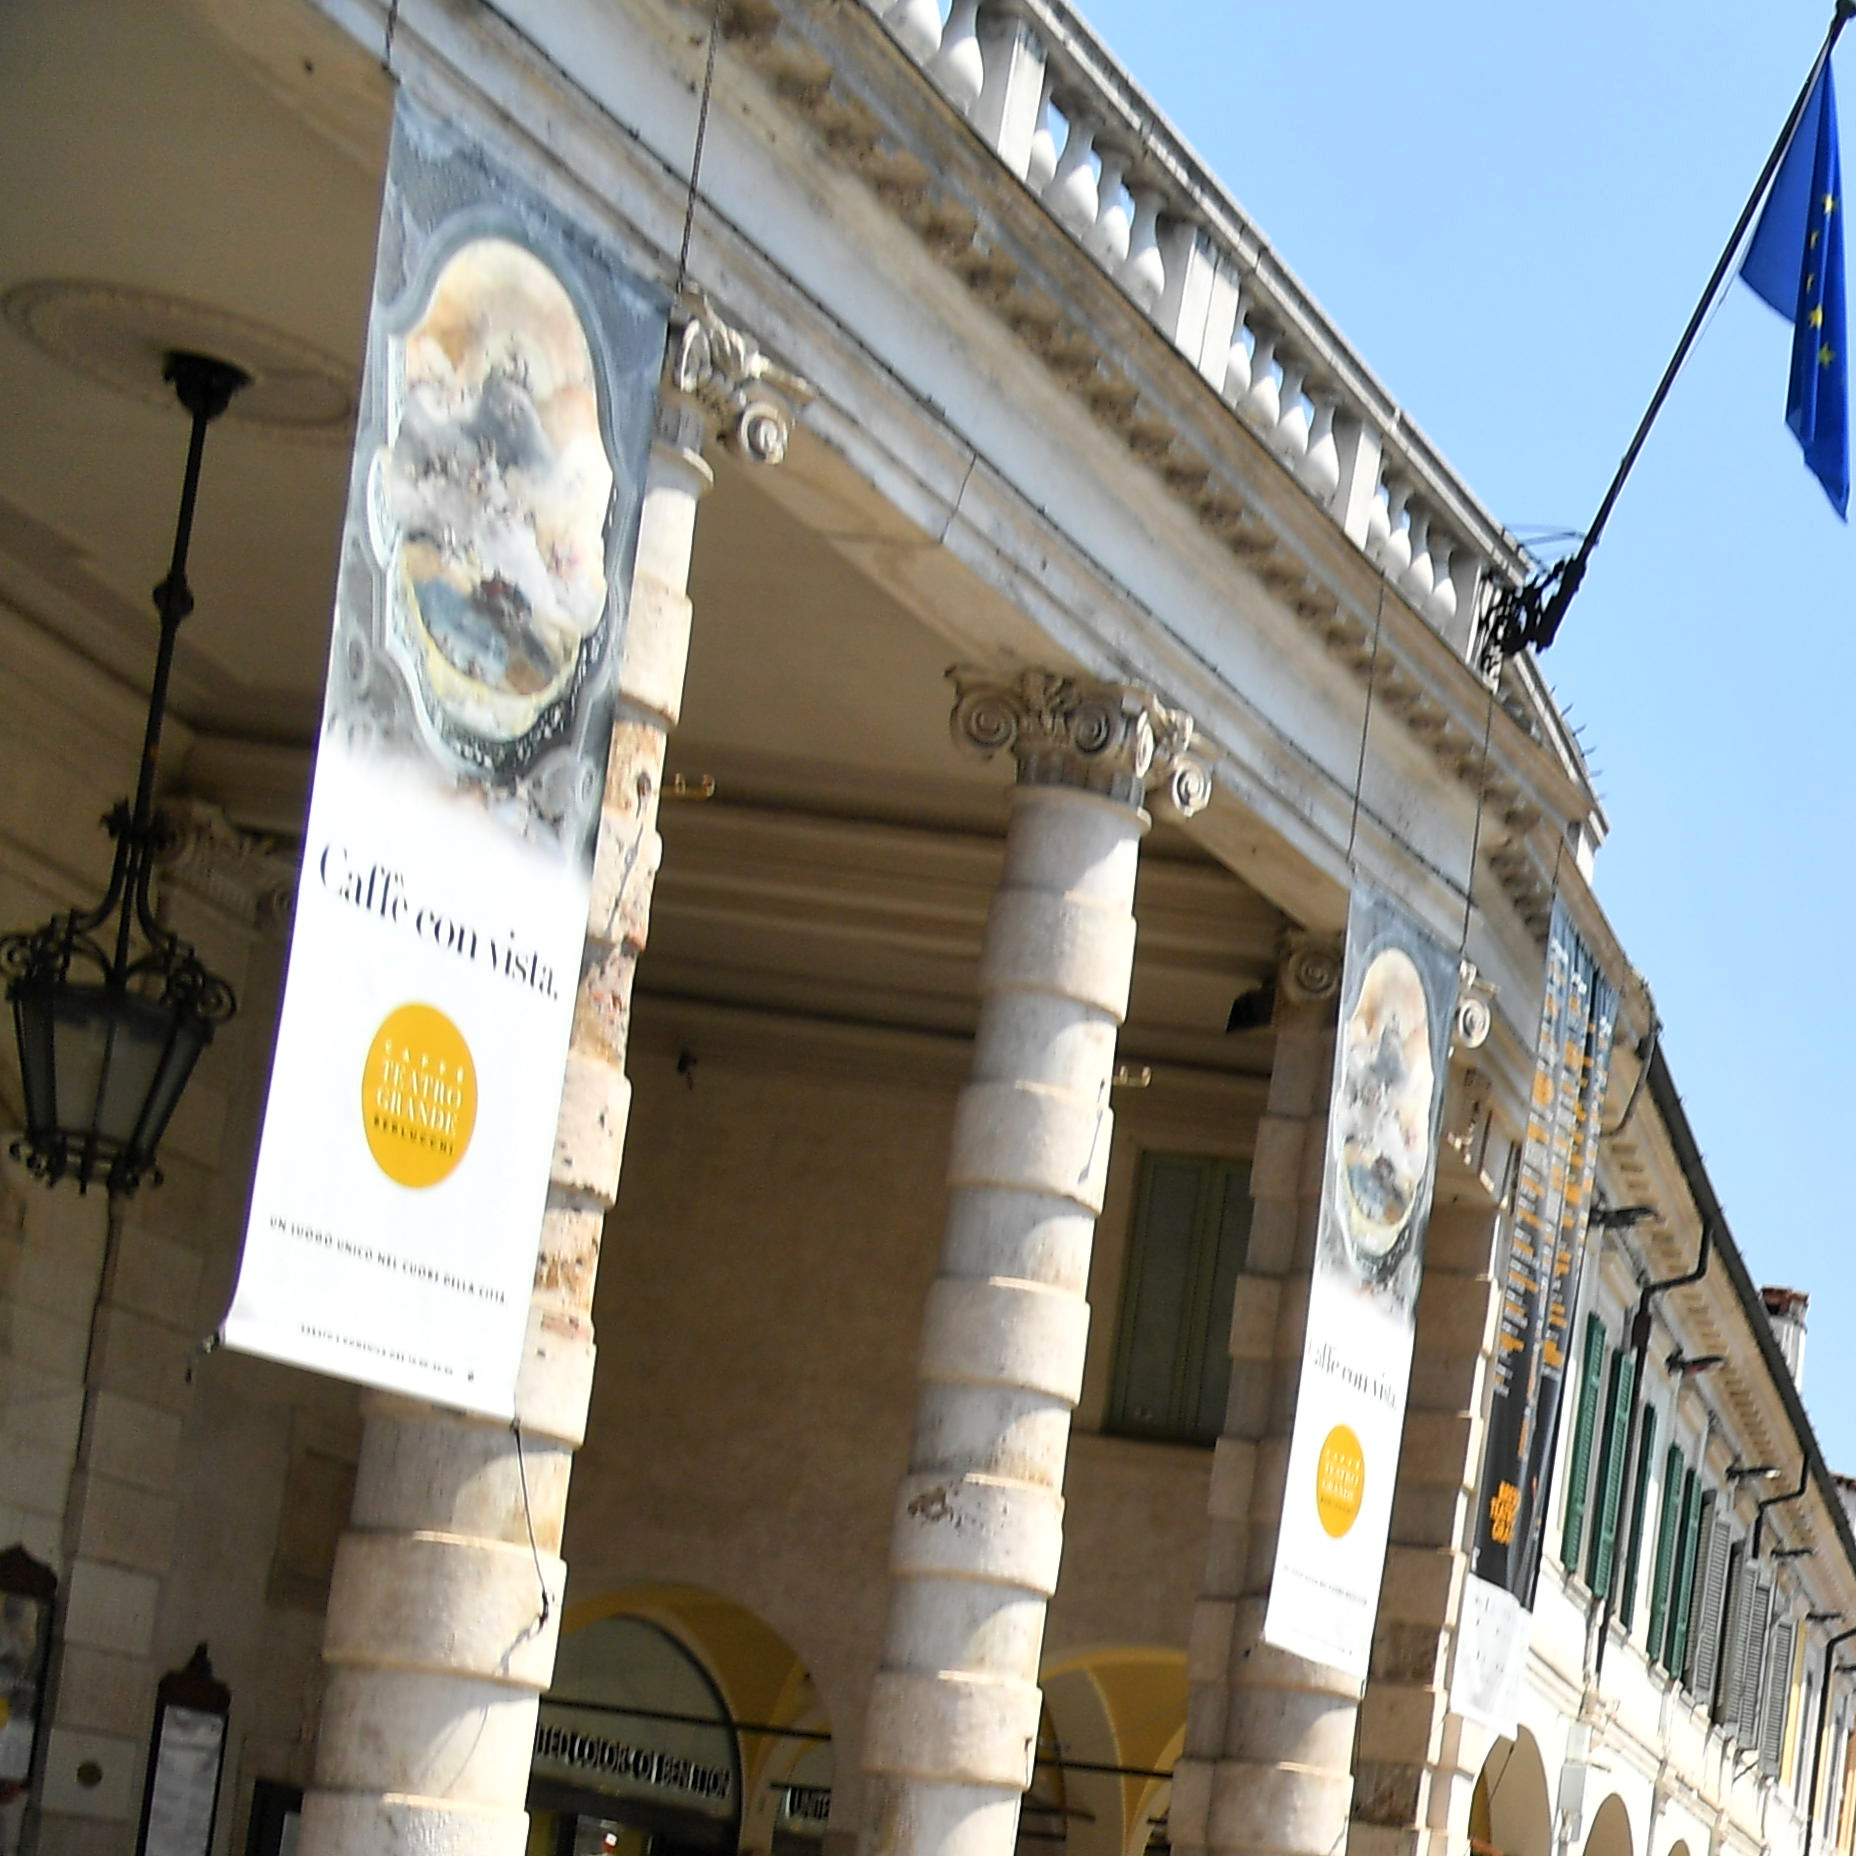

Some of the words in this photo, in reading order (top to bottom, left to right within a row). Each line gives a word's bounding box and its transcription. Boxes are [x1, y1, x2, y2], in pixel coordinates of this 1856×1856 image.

[415, 907, 477, 961] con
[489, 928, 558, 1002] vista.
[382, 1059, 463, 1111] TEATRO
[376, 1087, 457, 1138] GRANDE
